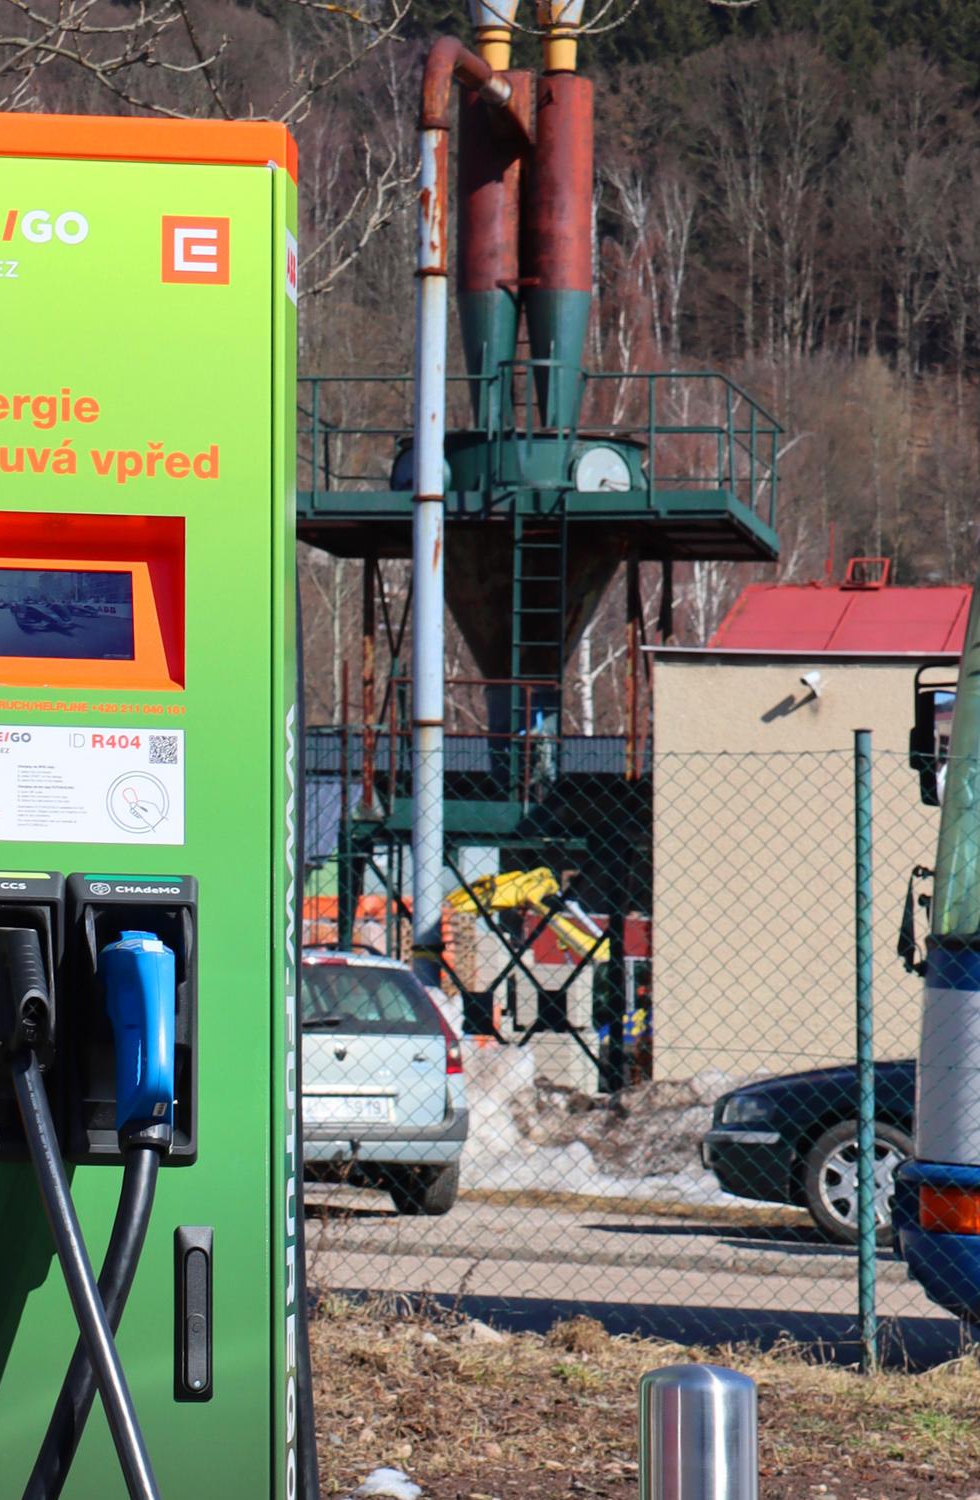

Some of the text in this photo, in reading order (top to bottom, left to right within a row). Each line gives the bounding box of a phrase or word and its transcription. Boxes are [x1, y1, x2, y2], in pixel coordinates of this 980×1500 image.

[90, 441, 219, 485] vpřed
[68, 732, 86, 749] ID
[91, 733, 141, 750] R404
[0, 881, 27, 891] CCS
[114, 885, 181, 895] CHAdeMO
